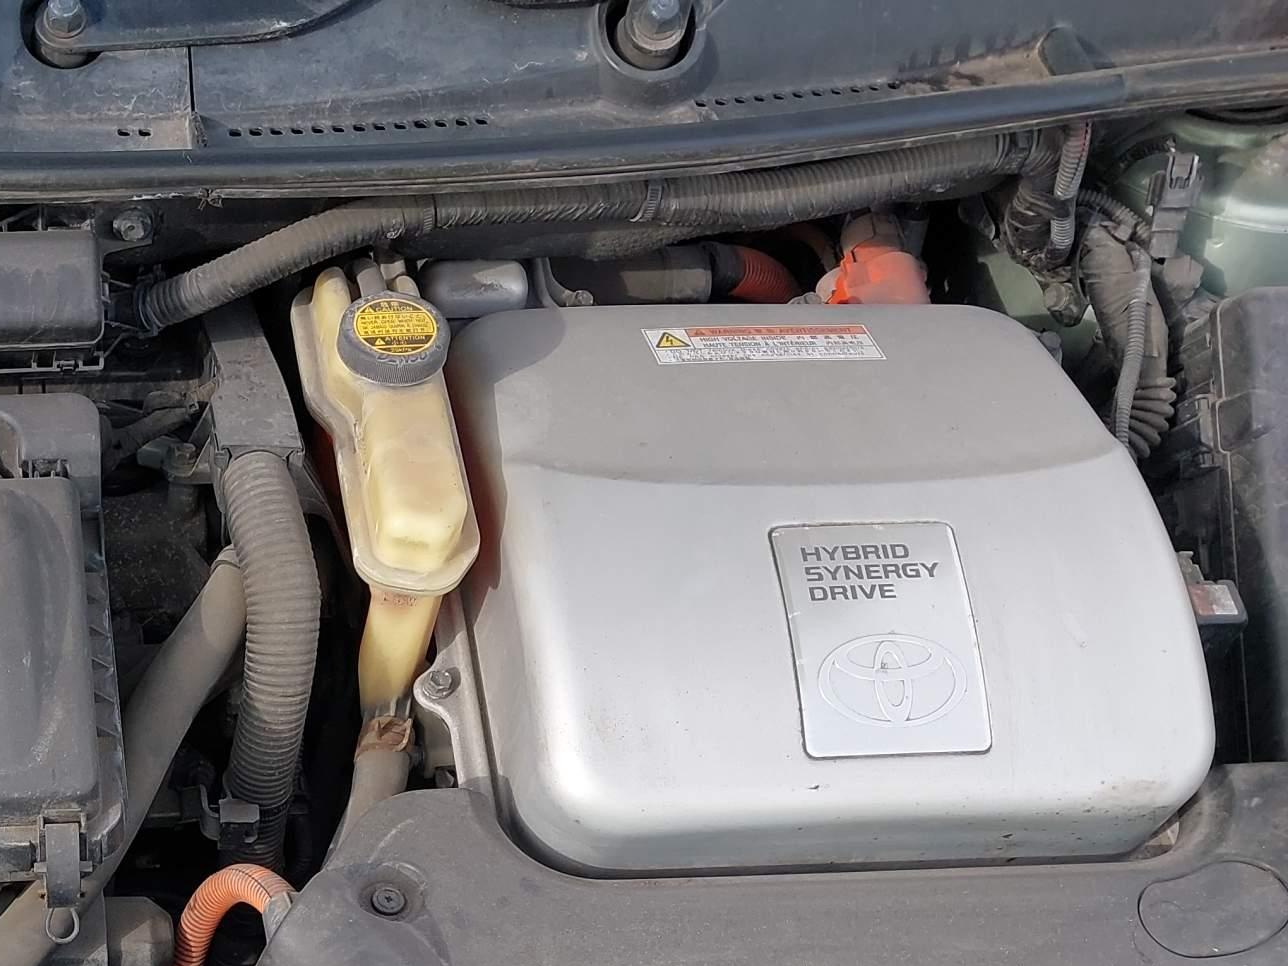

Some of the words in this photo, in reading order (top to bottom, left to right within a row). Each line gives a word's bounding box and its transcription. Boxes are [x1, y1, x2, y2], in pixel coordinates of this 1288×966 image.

[800, 543, 910, 562] HYBRID
[804, 562, 939, 582] SYNERGY
[808, 583, 897, 602] DRIVE
